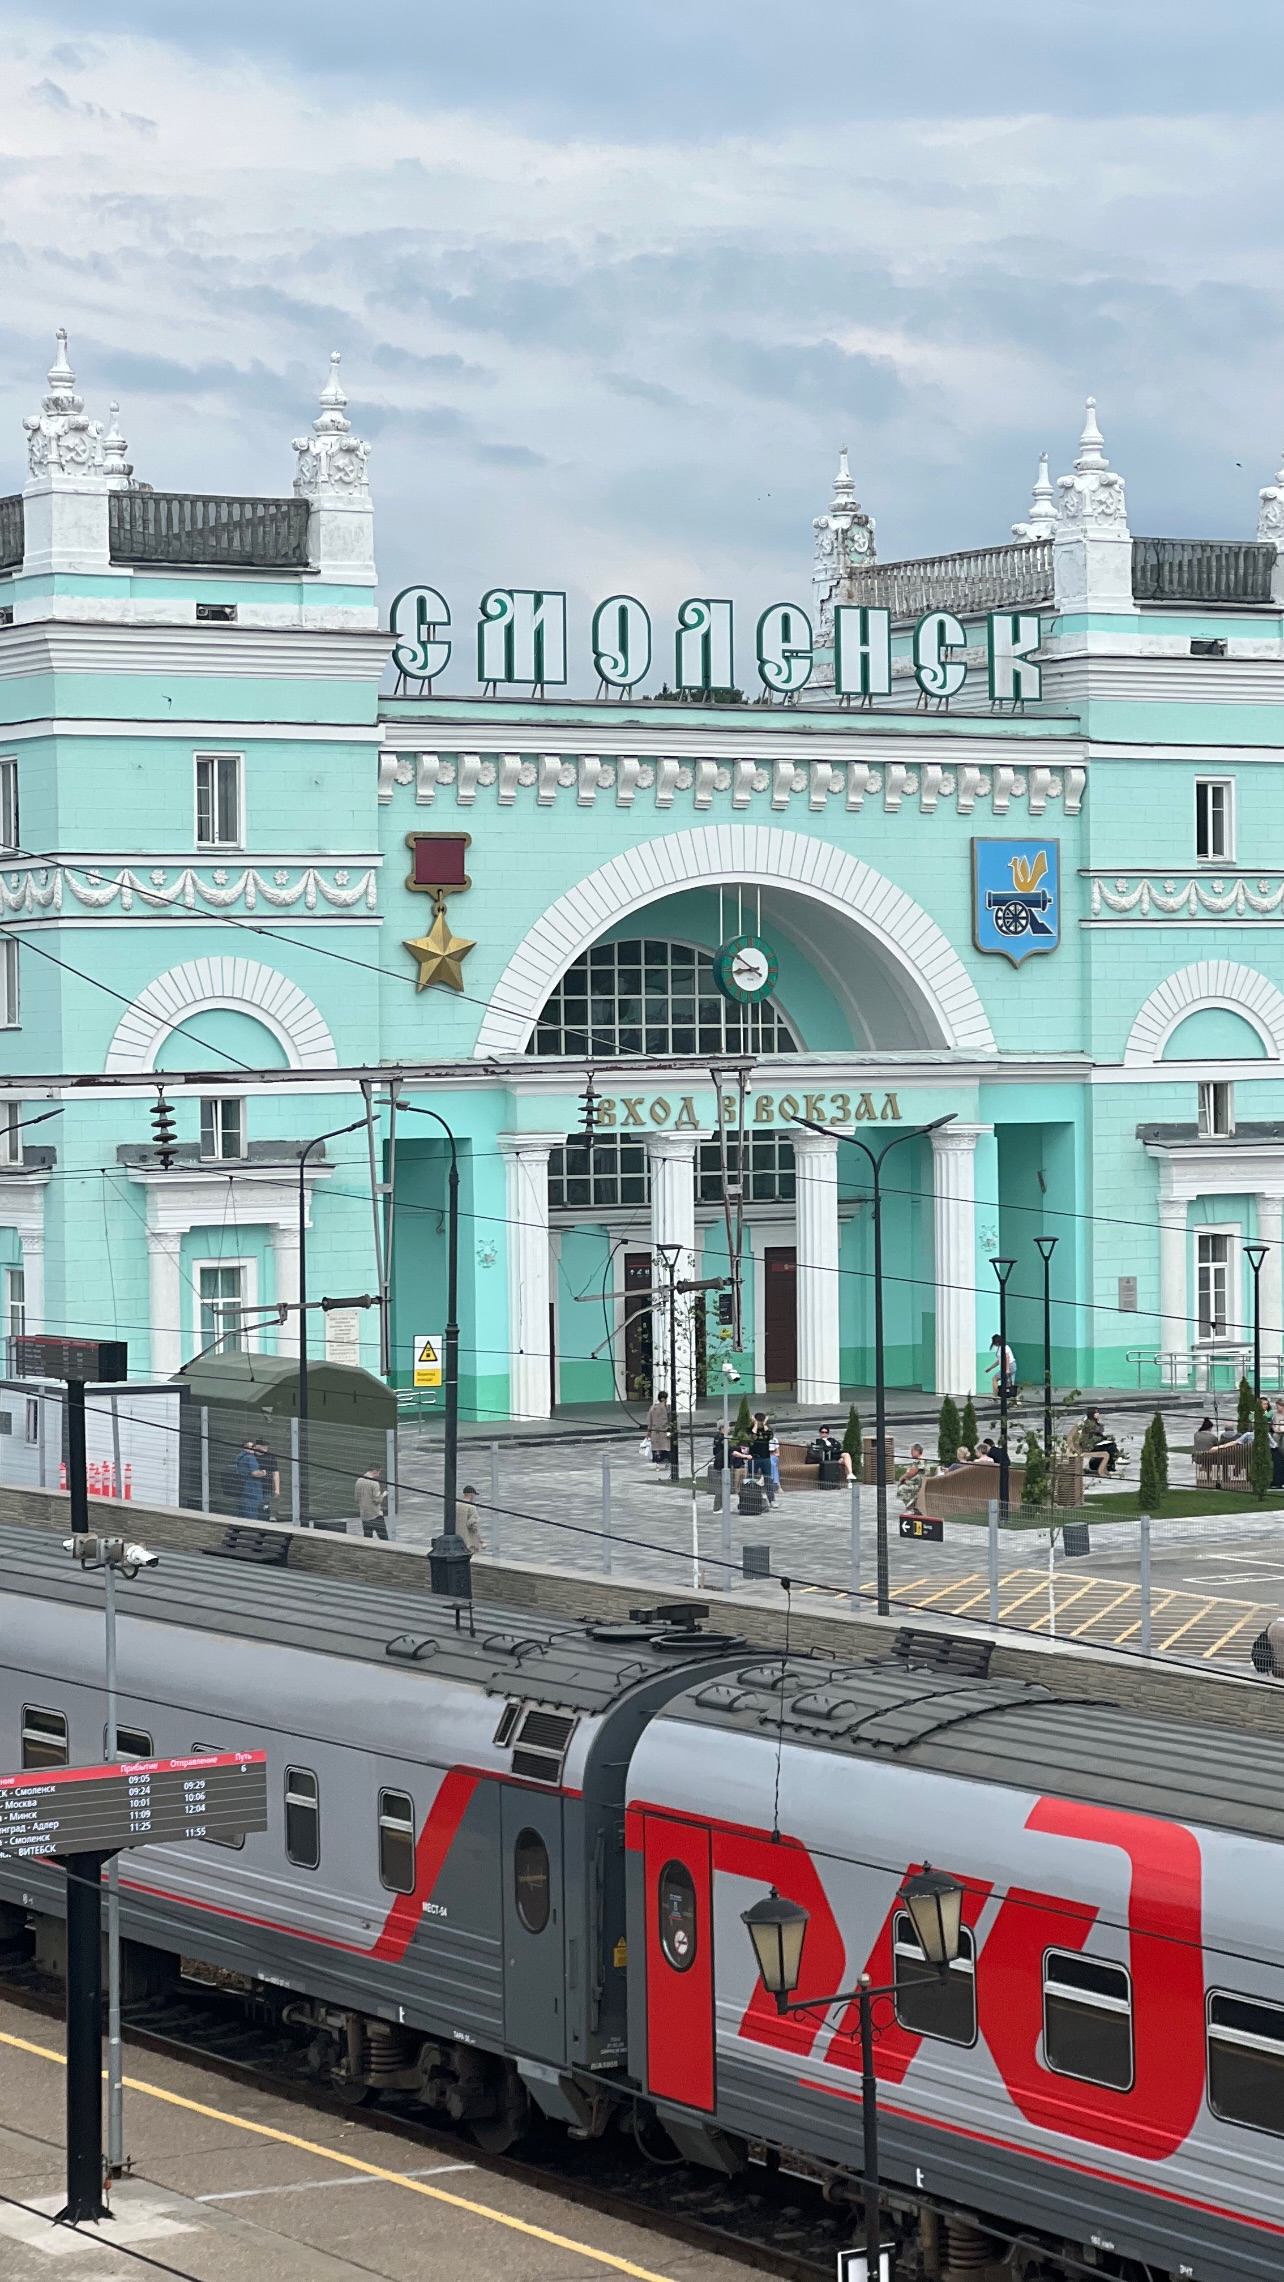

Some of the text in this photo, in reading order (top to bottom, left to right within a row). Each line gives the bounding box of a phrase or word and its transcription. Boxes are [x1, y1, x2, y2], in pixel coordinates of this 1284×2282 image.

[390, 585, 1042, 701] СМОЛЕНСК
[596, 1092, 903, 1130] ВХОД В ВОКЗАЛ
[121, 1763, 159, 1774] Прибытие
[170, 1757, 218, 1768] Отправление
[235, 1753, 253, 1762] Путь
[5, 1800, 38, 1810] Москва
[129, 1786, 151, 1796] 09:24
[184, 1780, 206, 1790] 09:29
[15, 1786, 56, 1797] Смоленск
[129, 1774, 150, 1784] 09:05
[241, 1764, 247, 1773] 6
[10, 1812, 38, 1821] Минск
[130, 1798, 150, 1808] 10:01
[185, 1792, 206, 1802] 10:06
[33, 1821, 60, 1831] Адлер
[130, 1809, 151, 1819] 11:09
[185, 1804, 206, 1814] 12:04
[10, 1834, 51, 1845] Смоленск
[130, 1821, 151, 1832] 11:25
[19, 1844, 57, 1857] ВИТЕБСК
[185, 1827, 206, 1837] 11:55
